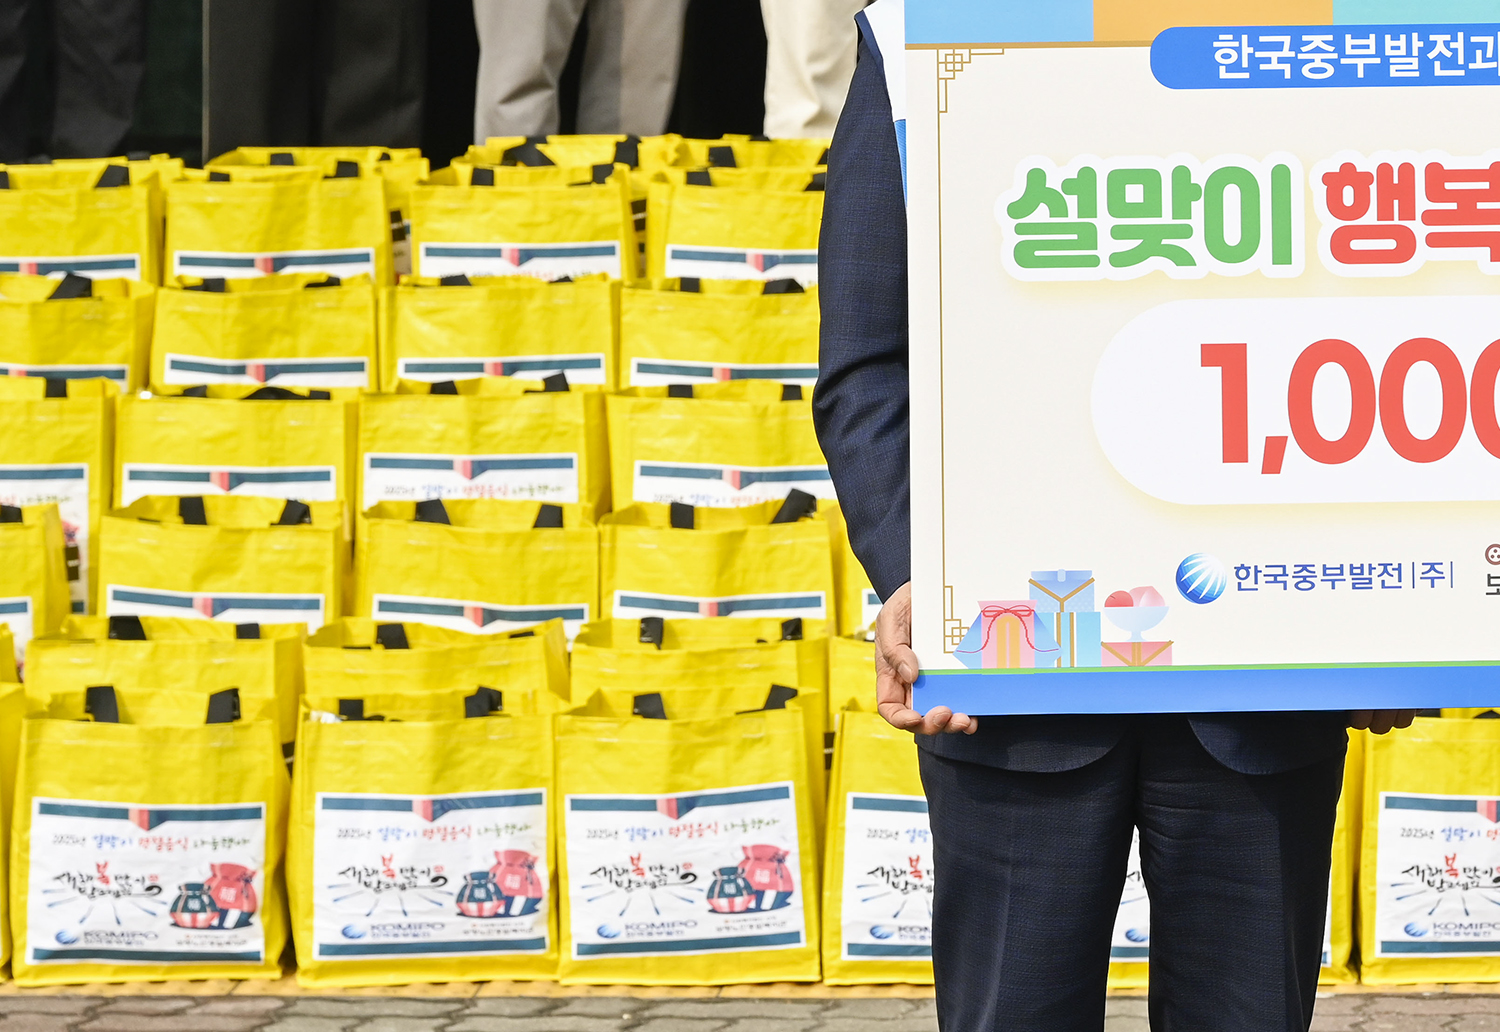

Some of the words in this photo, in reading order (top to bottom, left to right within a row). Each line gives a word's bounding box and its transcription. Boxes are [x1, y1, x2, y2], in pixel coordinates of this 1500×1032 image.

[1008, 164, 1292, 268] 설맞이
[1400, 827, 1434, 839] 2025년
[1440, 826, 1481, 842] 설맞이
[909, 854, 923, 880] 복
[1402, 865, 1443, 883] 새해
[1445, 853, 1459, 879] 복
[1463, 866, 1493, 880] 많이
[625, 920, 698, 930] KOMIPO
